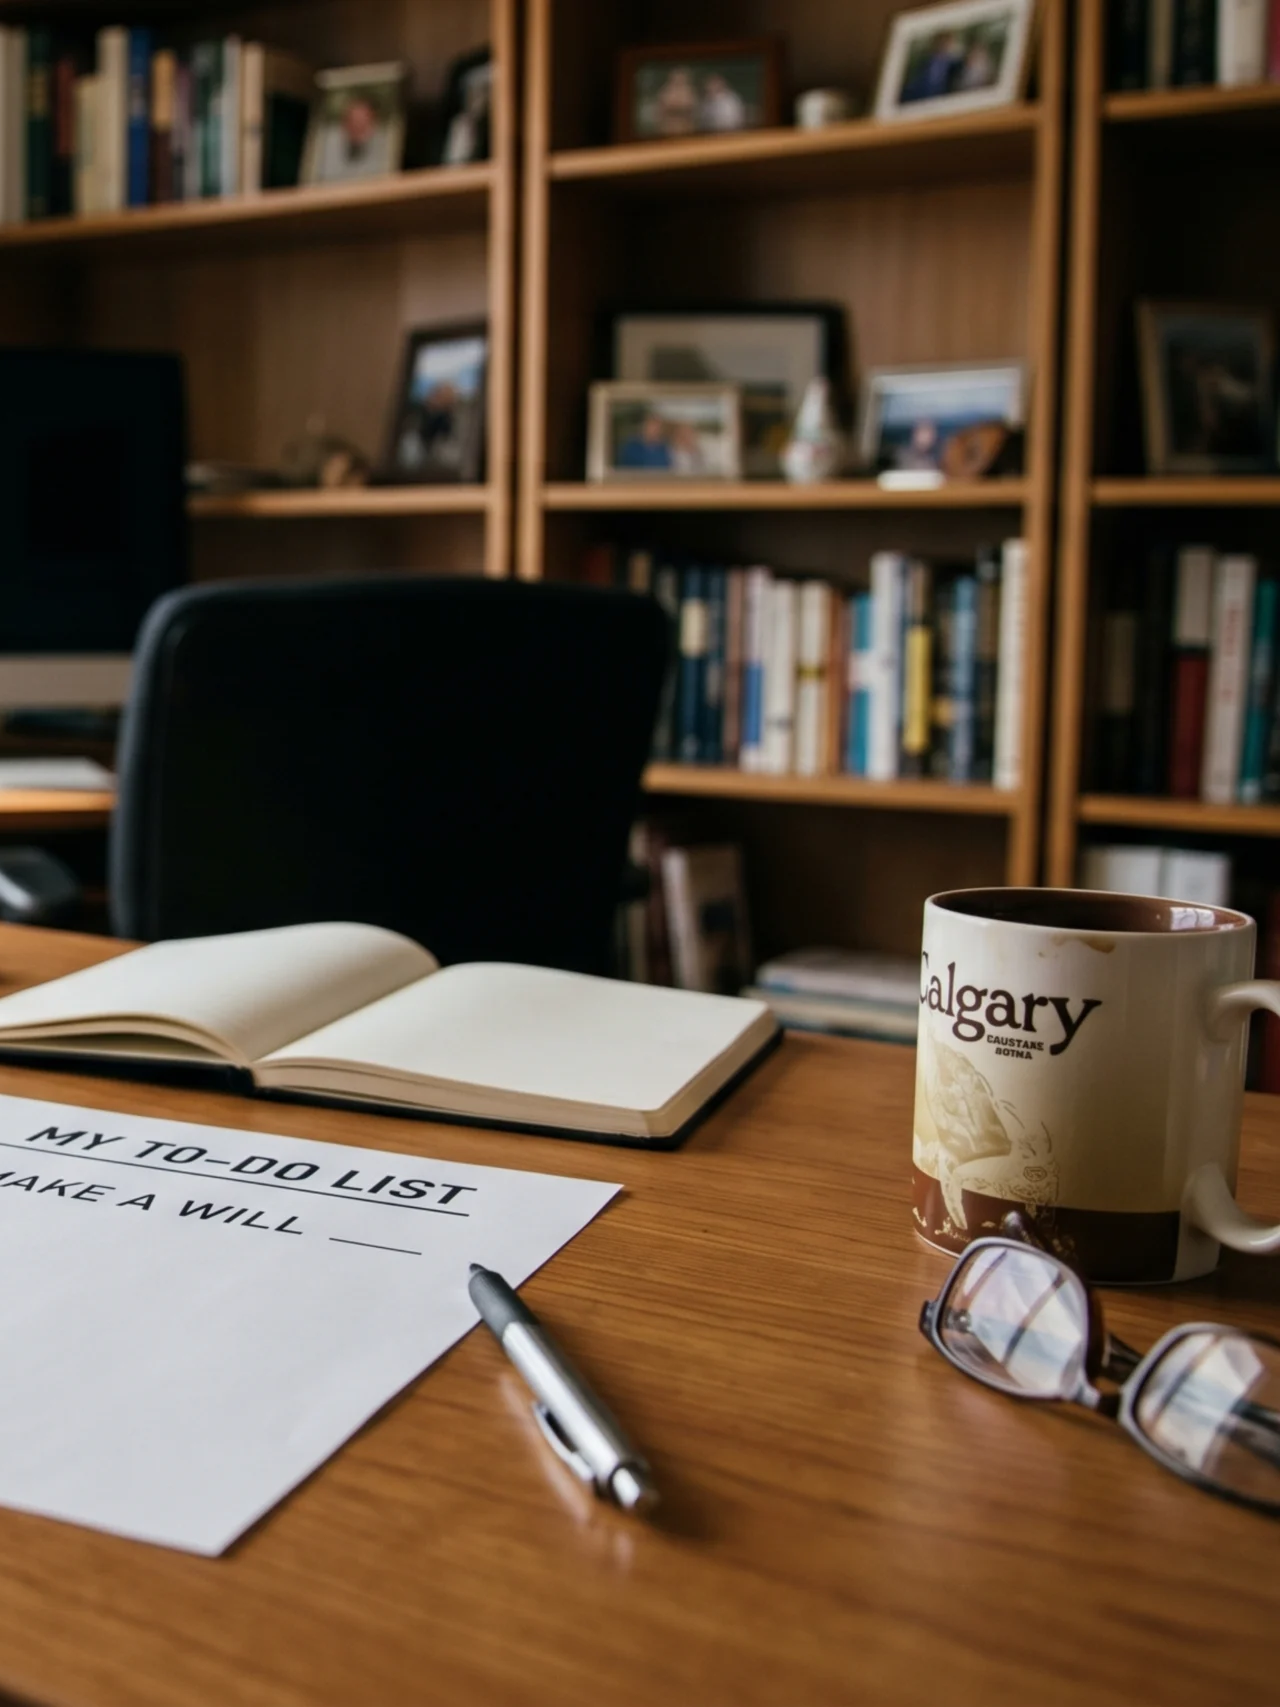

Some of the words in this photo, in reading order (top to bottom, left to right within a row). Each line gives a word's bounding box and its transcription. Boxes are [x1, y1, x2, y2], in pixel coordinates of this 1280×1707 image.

[24, 1126, 126, 1151] MY
[134, 1140, 321, 1182] TO-DO
[329, 1169, 478, 1206] LIST
[115, 1193, 156, 1212] A
[178, 1199, 304, 1236] WILL
